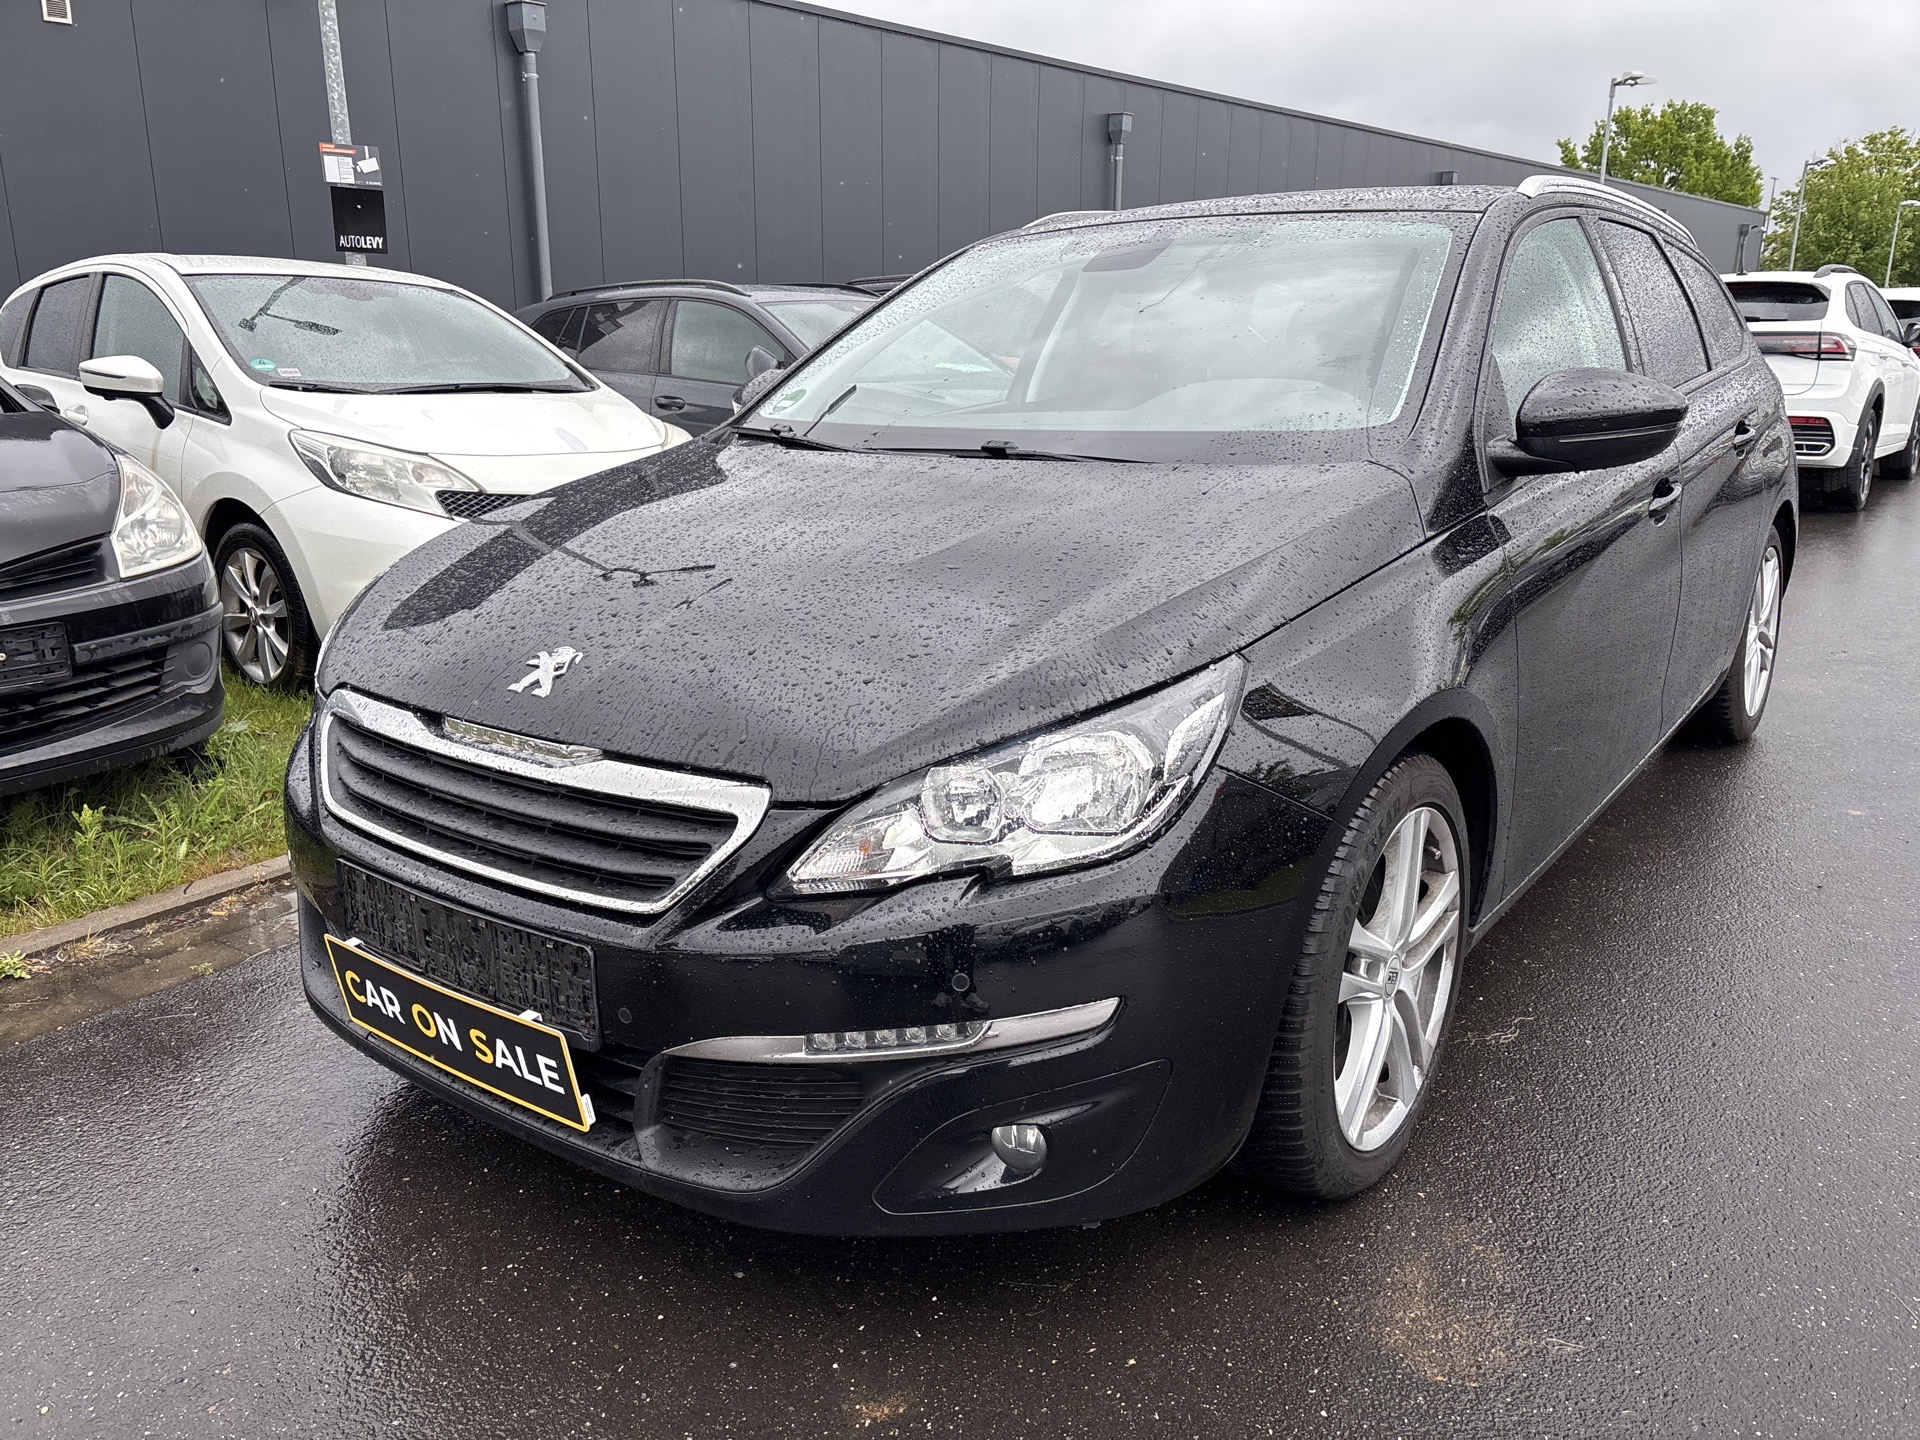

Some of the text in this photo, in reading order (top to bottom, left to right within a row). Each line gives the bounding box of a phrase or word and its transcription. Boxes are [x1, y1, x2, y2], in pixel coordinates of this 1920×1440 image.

[340, 234, 383, 249] AUTOLEVY
[458, 723, 540, 752] PEUGEO
[345, 970, 565, 1094] CAR ON SALE
